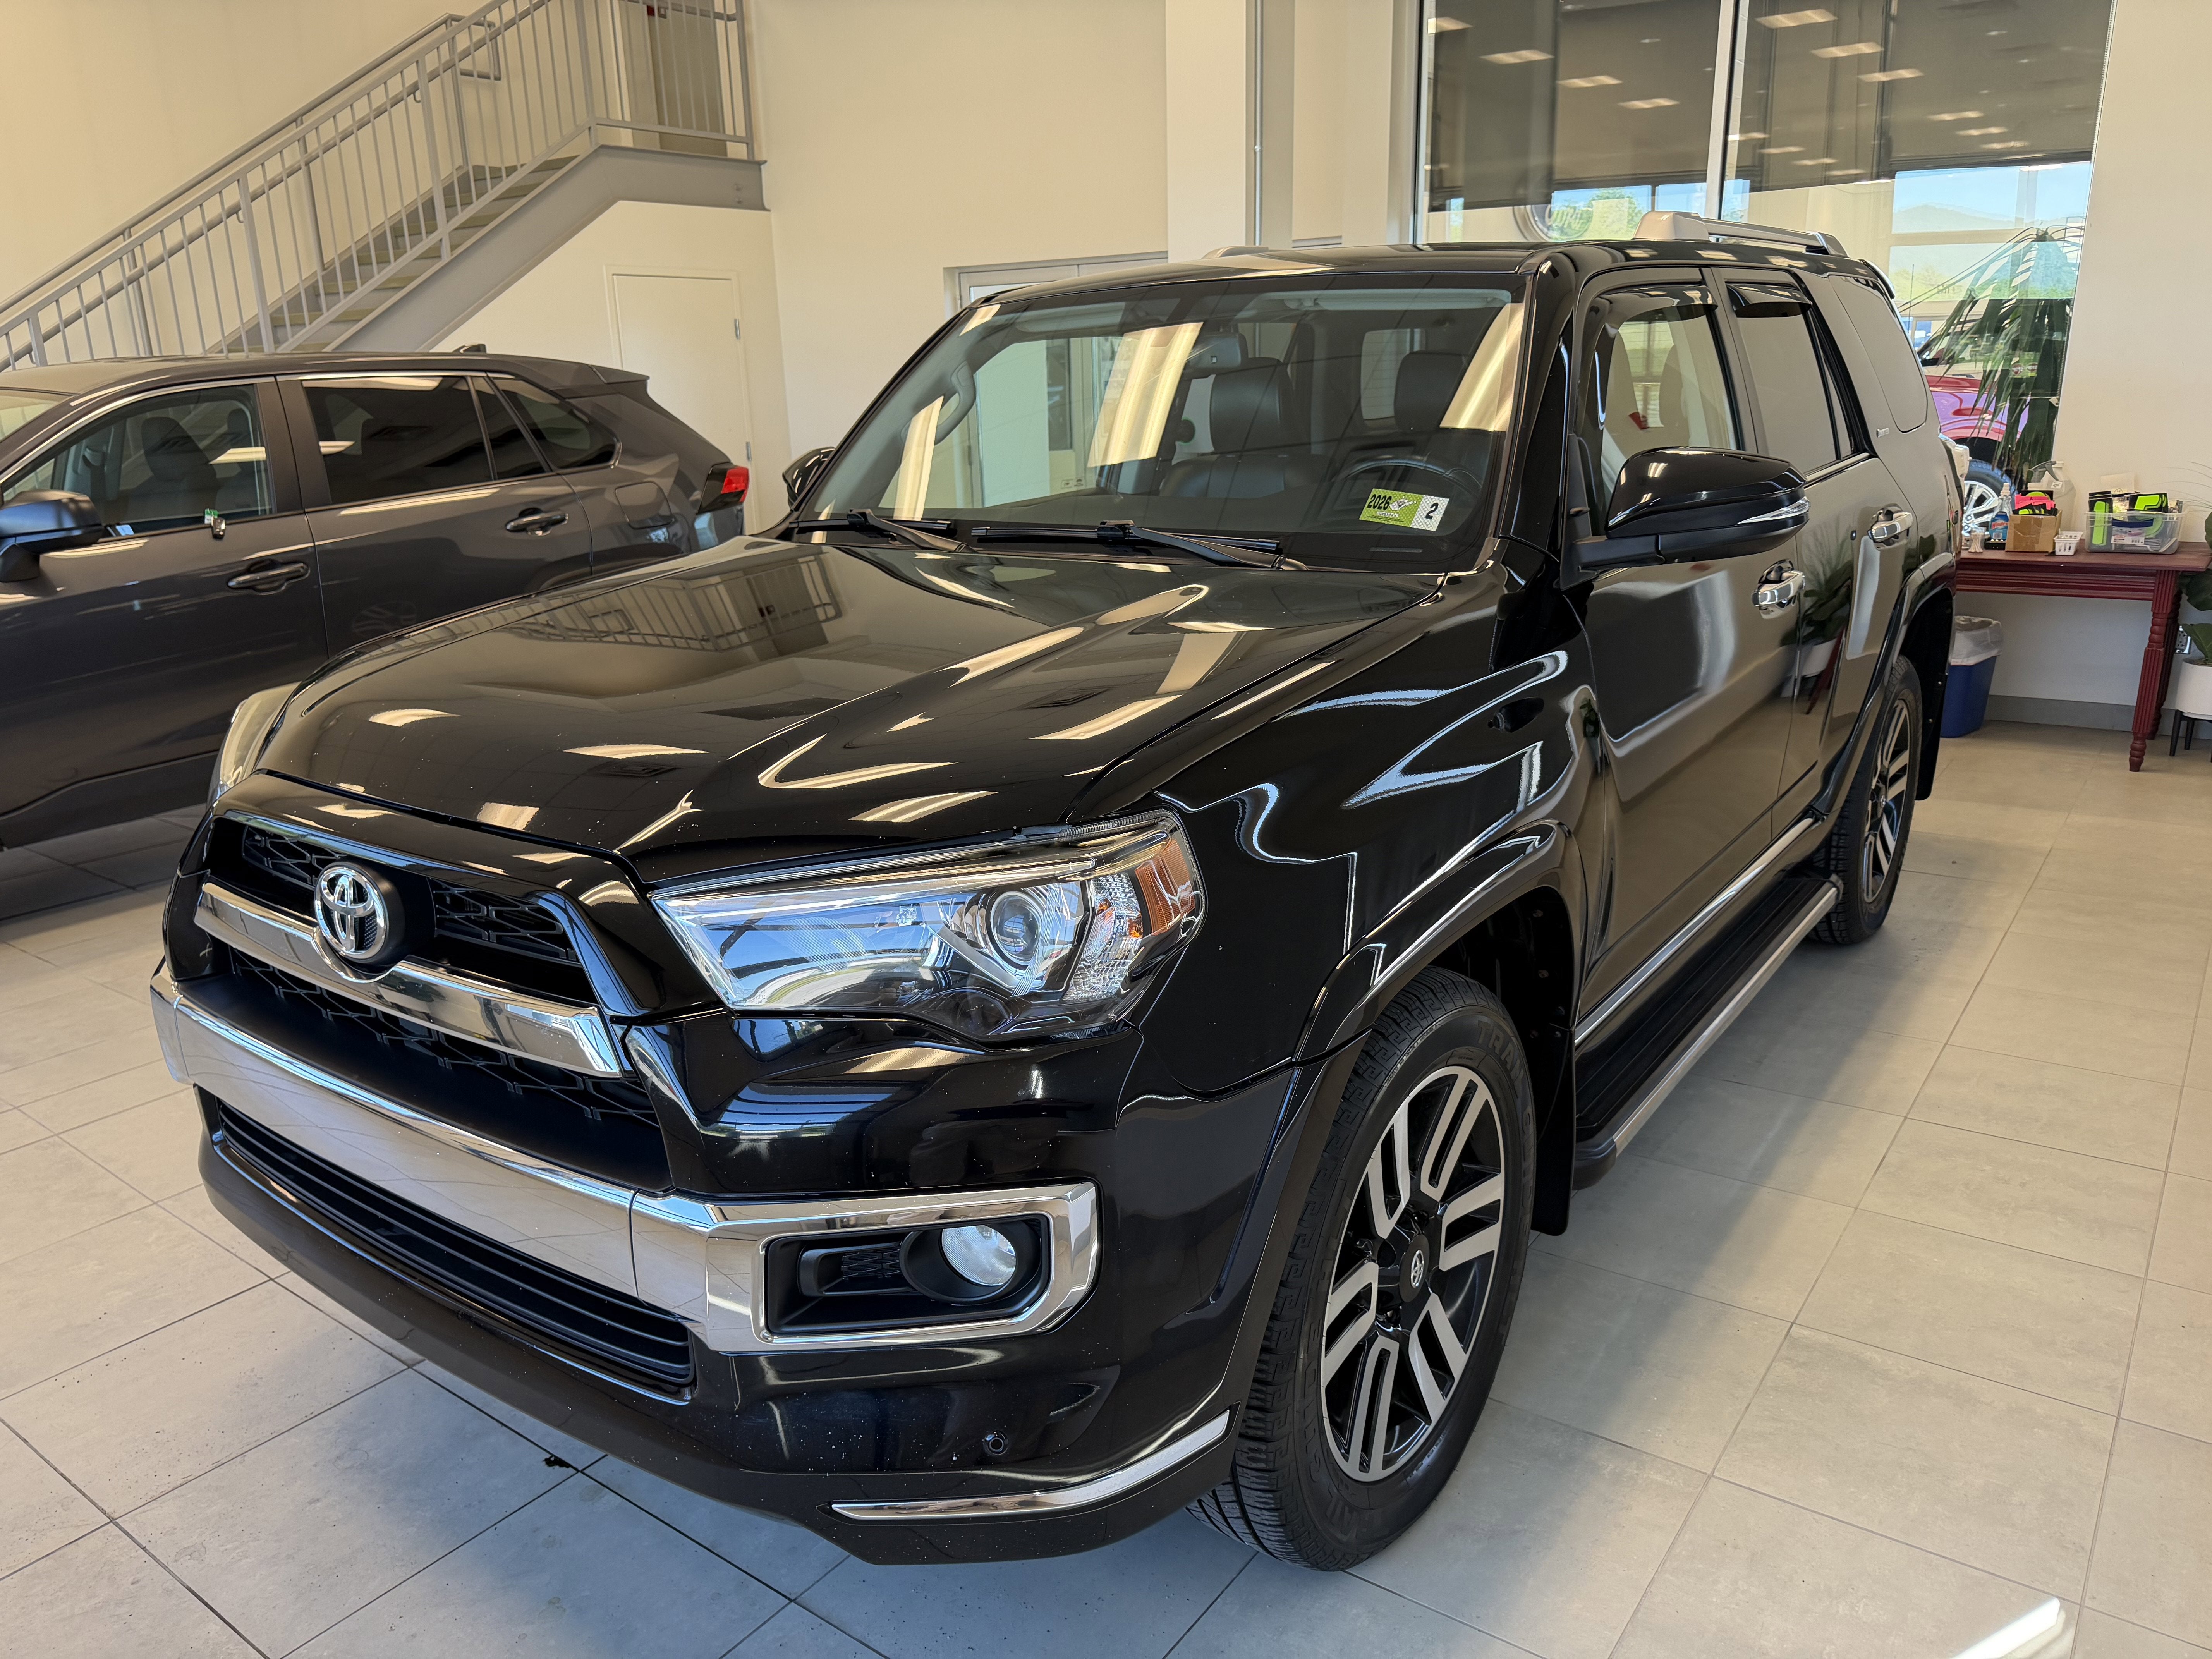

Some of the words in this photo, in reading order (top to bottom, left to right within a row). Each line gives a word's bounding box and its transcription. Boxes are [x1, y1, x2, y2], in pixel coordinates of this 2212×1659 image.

[1367, 494, 1392, 510] 2026
[1425, 502, 1439, 519] 2
[1478, 1020, 1525, 1099] TRAIL
